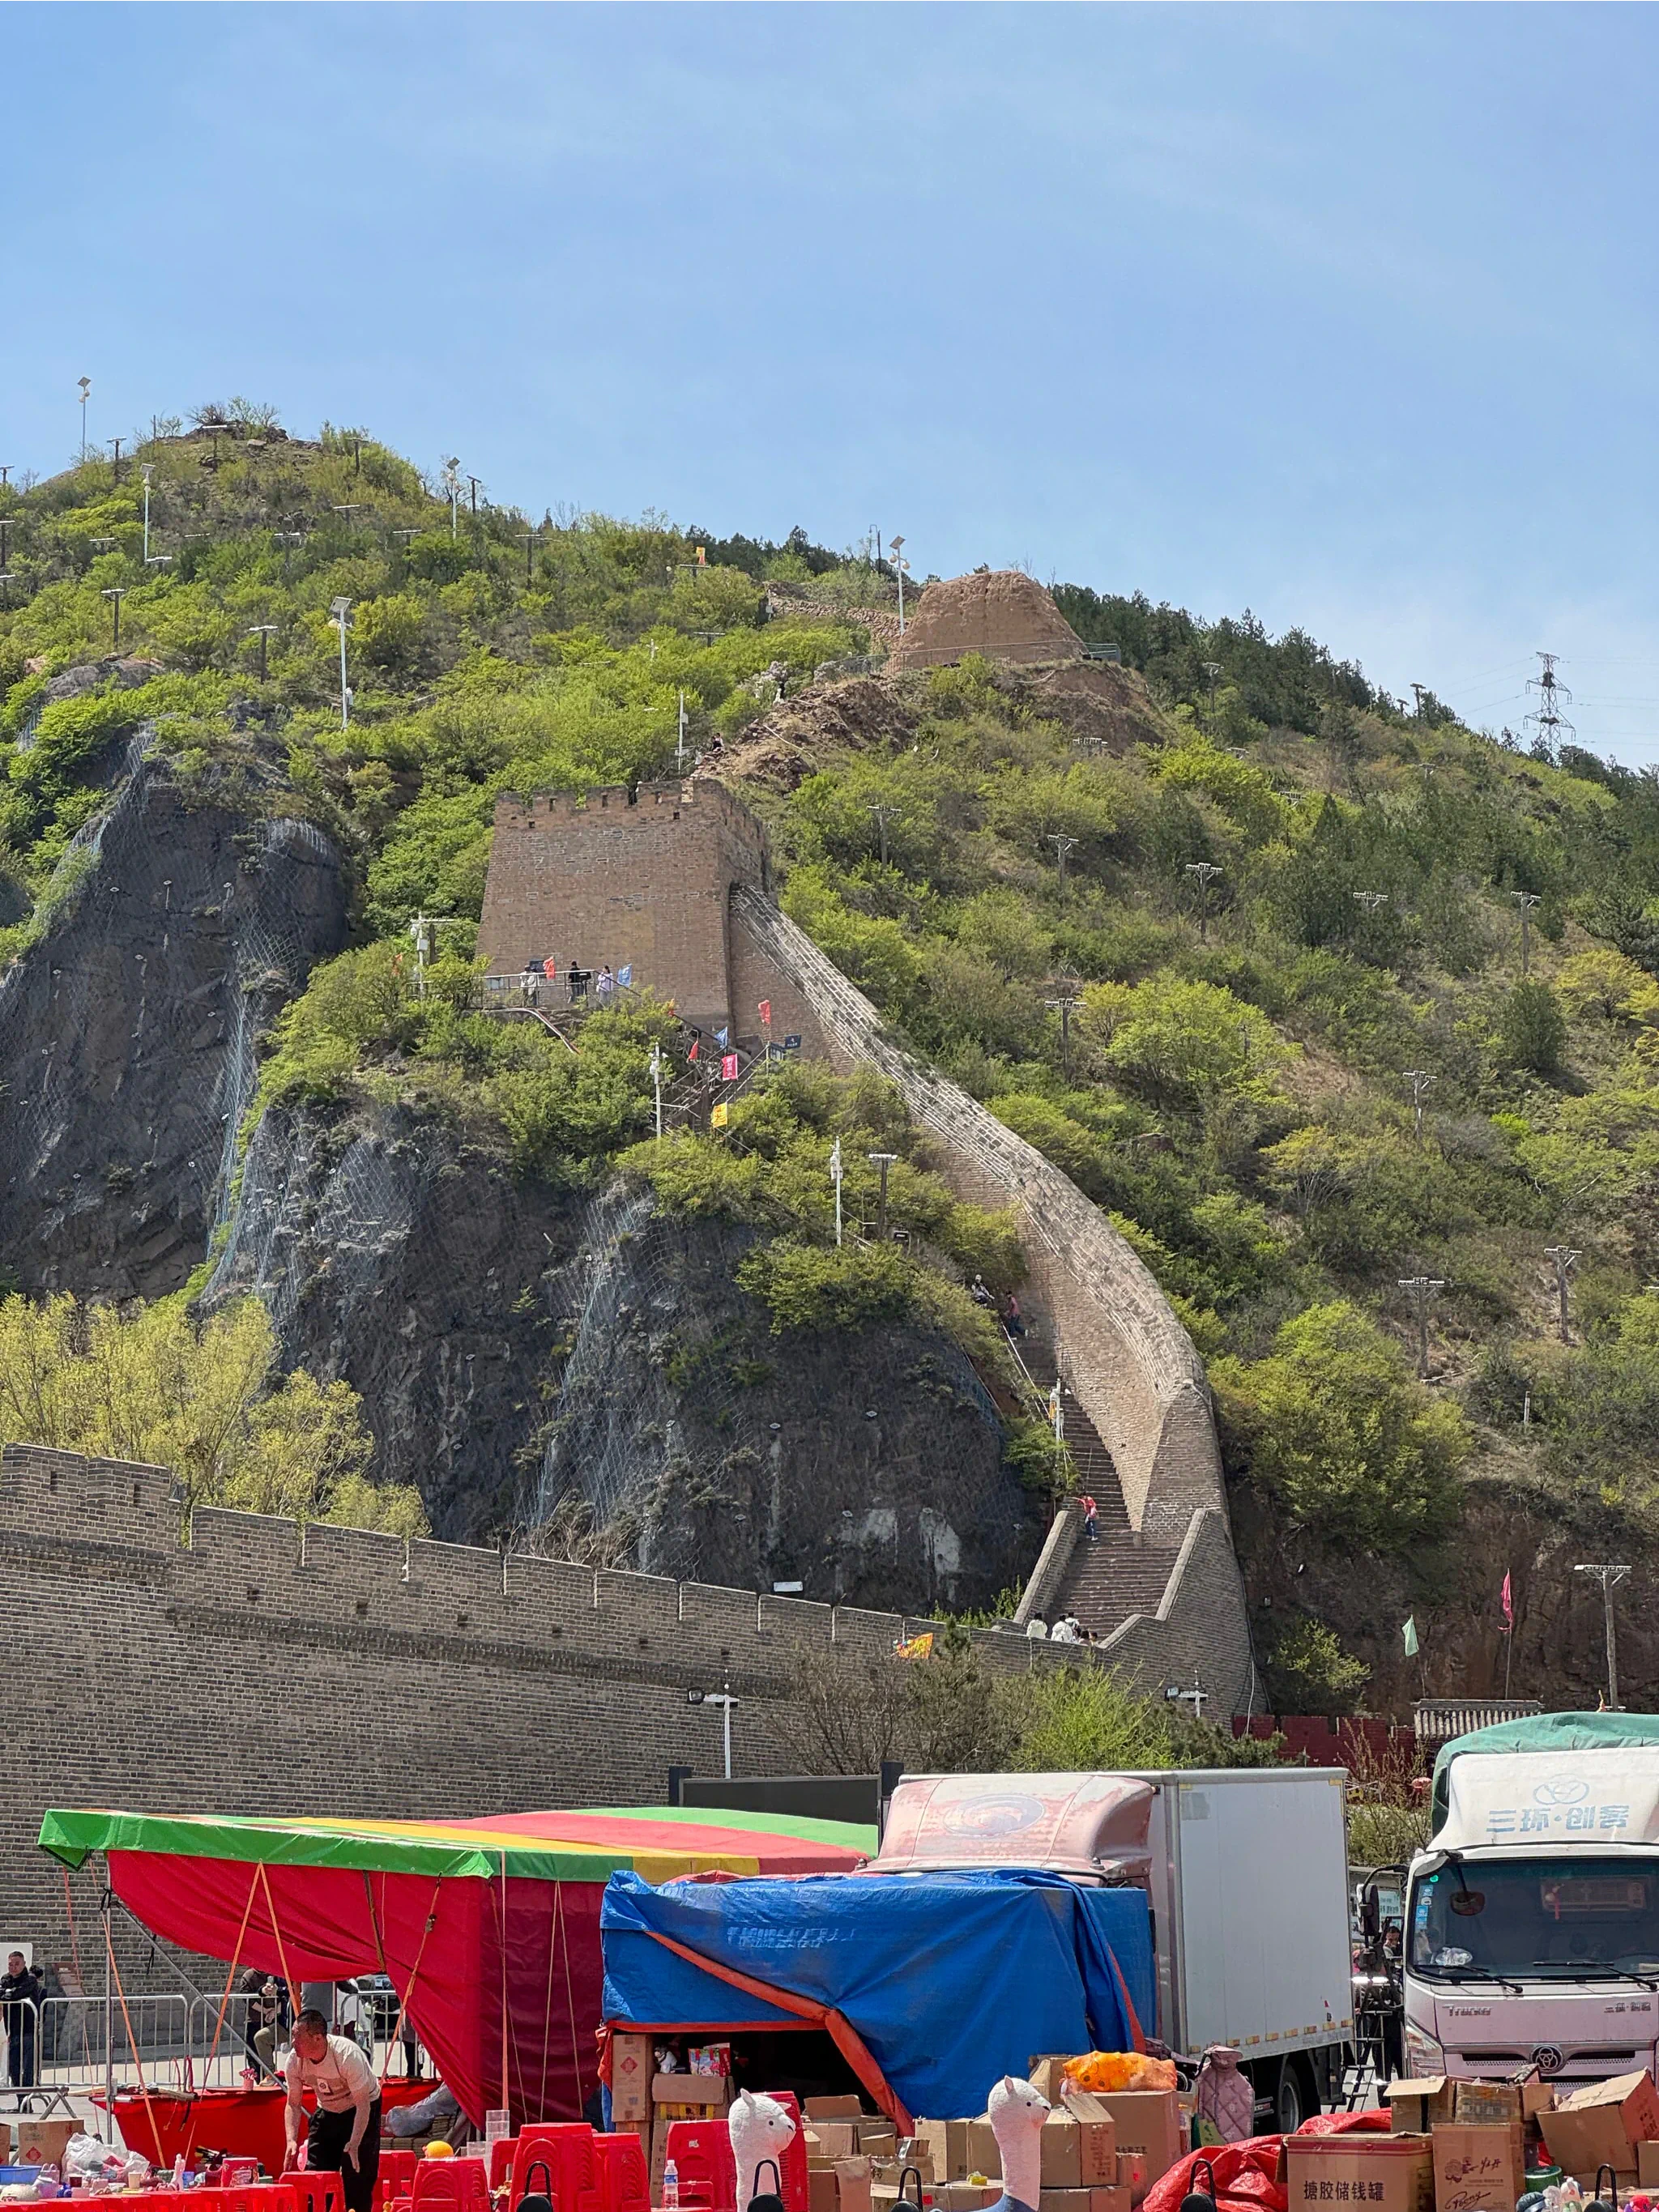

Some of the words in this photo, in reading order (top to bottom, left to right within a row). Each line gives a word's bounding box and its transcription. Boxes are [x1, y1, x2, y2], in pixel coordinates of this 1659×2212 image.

[1486, 1805, 1630, 1833] 三环·创客
[1303, 2180, 1384, 2201] 搪胶储钱罐
